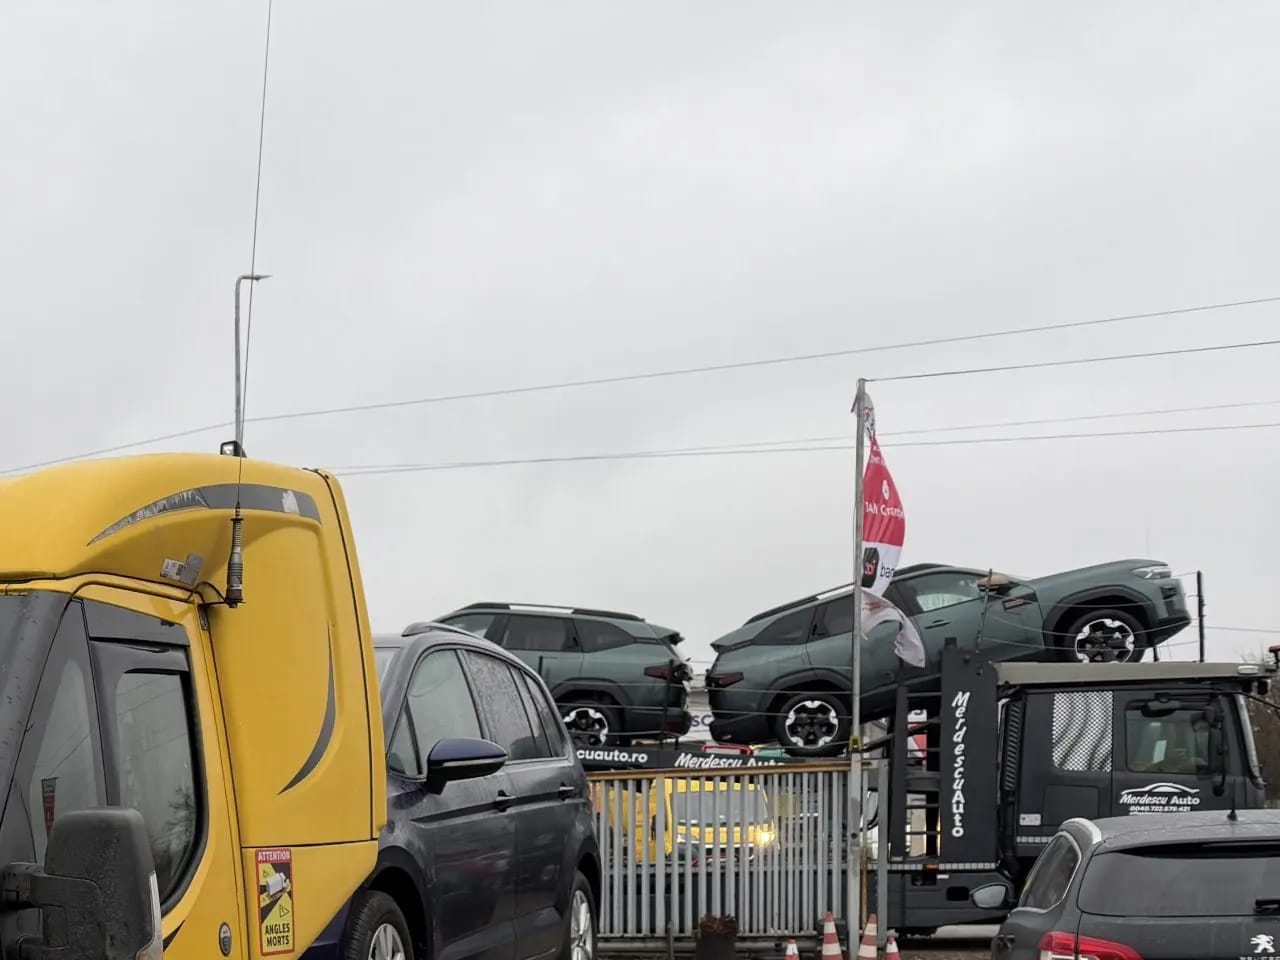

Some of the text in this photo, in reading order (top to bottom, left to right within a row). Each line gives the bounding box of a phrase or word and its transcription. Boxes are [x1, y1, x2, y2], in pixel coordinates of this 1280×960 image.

[1120, 794, 1200, 805] Merdescu Auto
[257, 850, 290, 862] ATTENTION
[264, 922, 290, 936] ANGLES
[266, 934, 290, 948] MORTS
